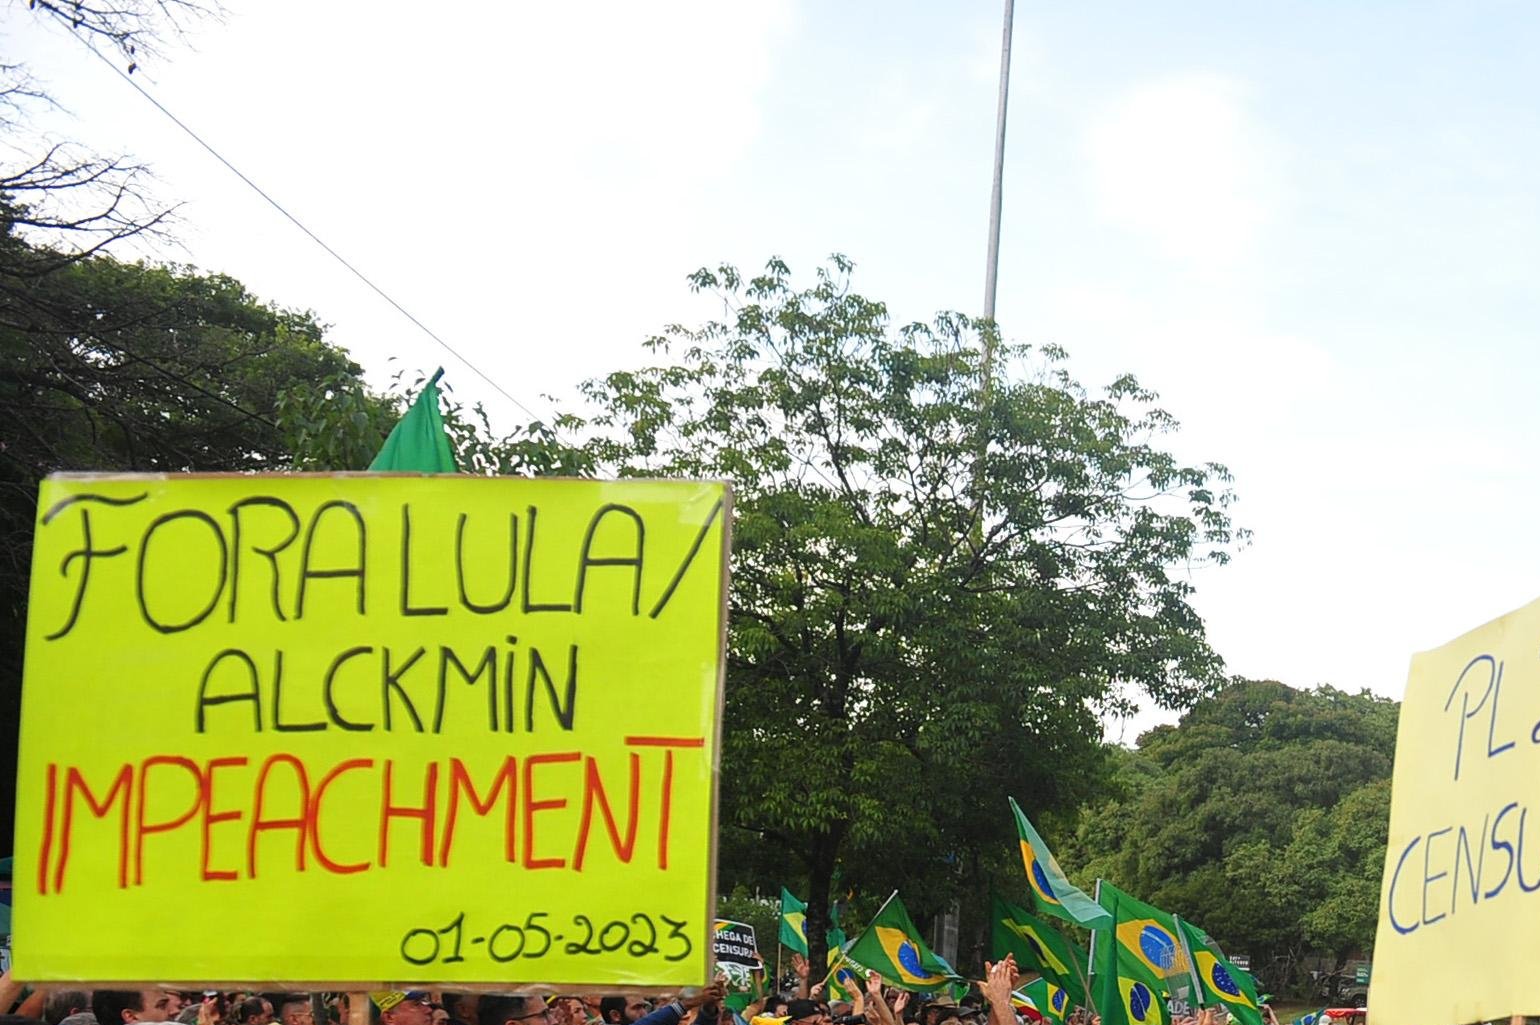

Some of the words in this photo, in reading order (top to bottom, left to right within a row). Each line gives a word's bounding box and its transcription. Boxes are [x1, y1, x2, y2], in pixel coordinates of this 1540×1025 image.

[42, 492, 366, 641] FORA
[1445, 655, 1515, 781] PL
[38, 736, 705, 896] IMPEACHMENT
[400, 912, 693, 965] 01-05-2023
[713, 928, 742, 942] HEGA
[743, 934, 754, 945] DE
